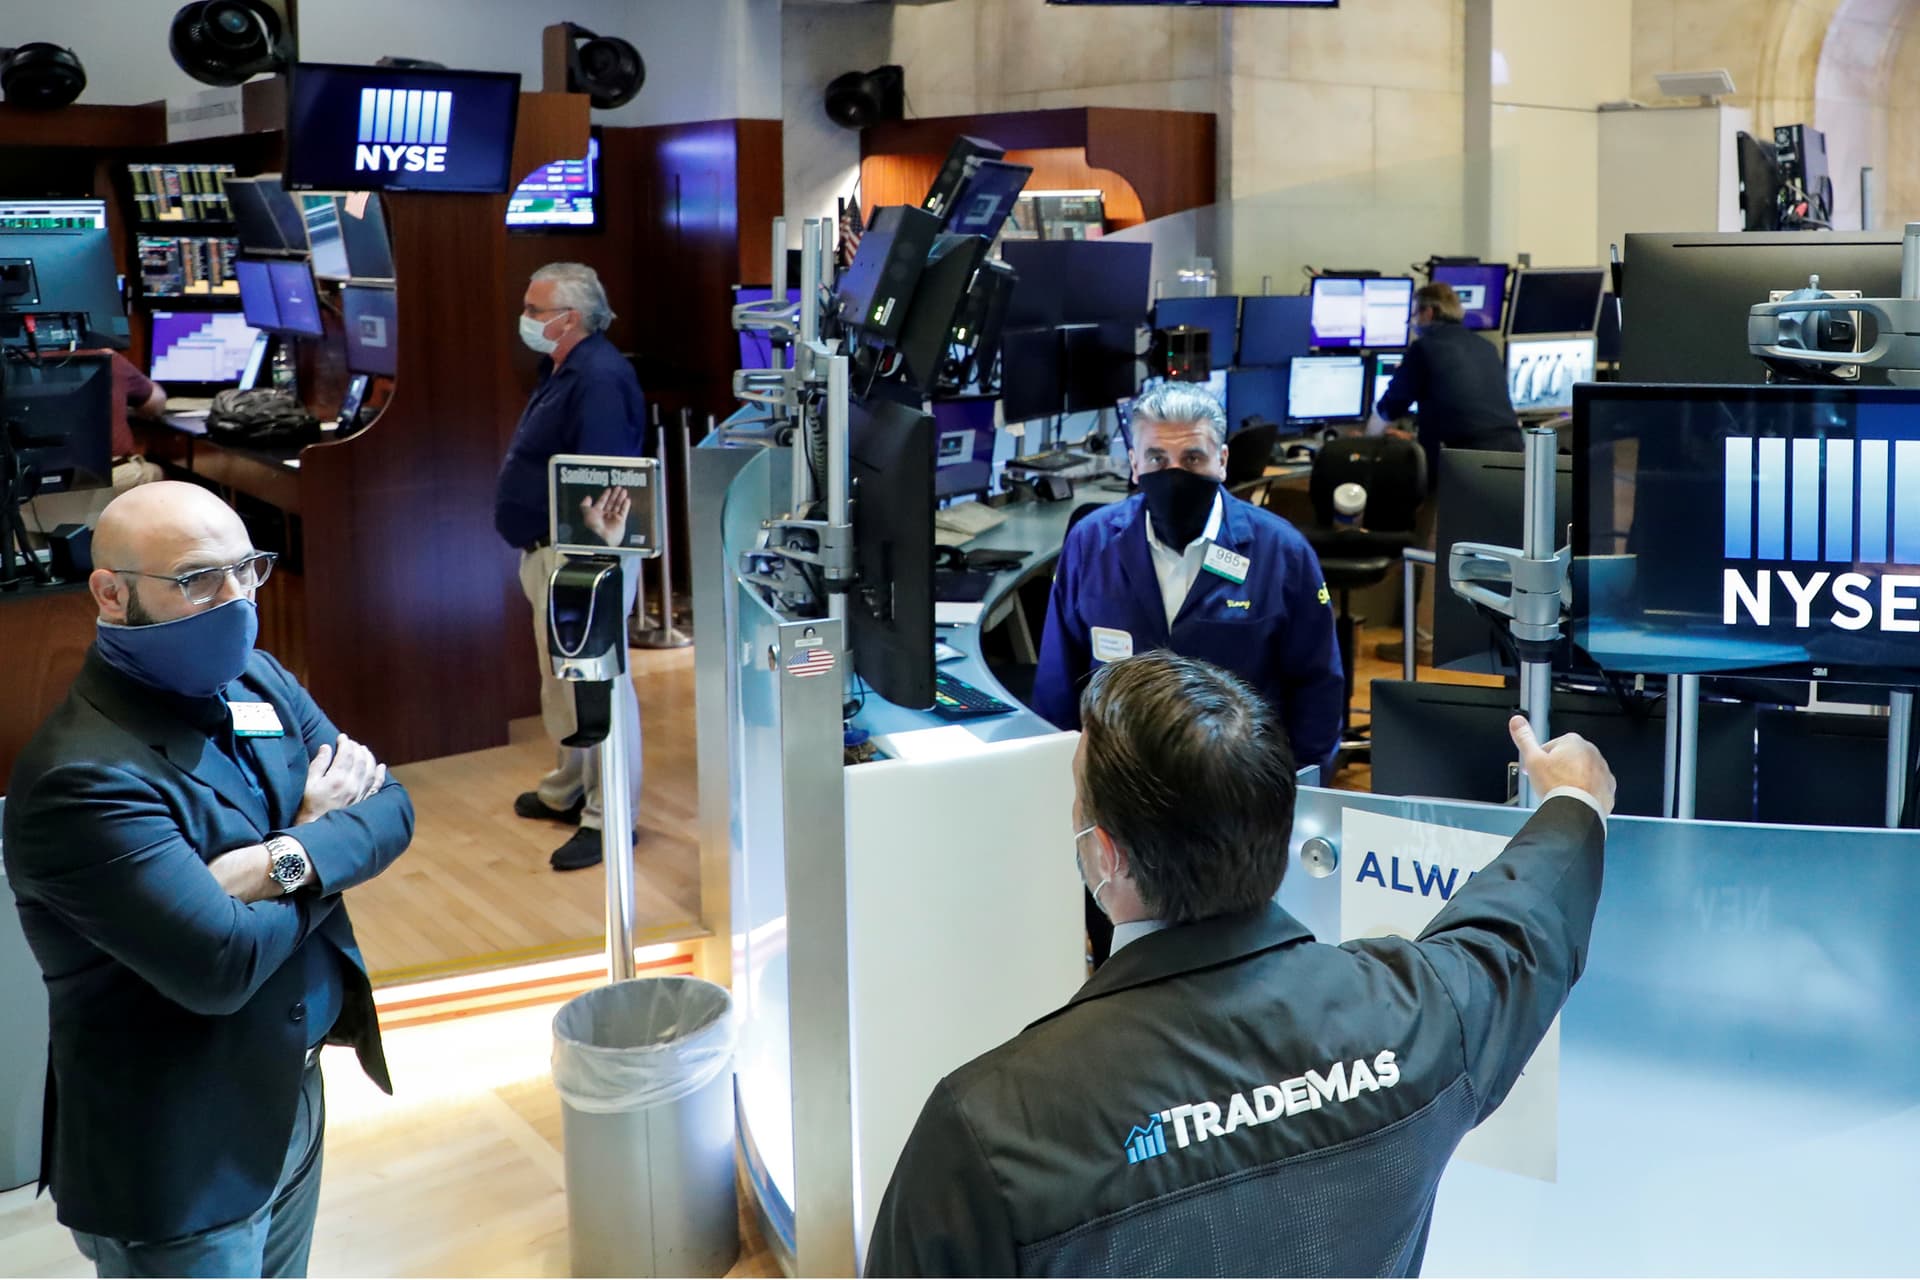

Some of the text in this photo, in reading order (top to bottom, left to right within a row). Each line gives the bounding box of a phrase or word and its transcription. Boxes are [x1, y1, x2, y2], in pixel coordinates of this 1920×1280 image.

[355, 144, 448, 172] NYSE
[611, 468, 647, 487] Station
[1216, 548, 1241, 568] 985
[1723, 568, 1920, 632] NYSE
[1812, 667, 1828, 677] 3M
[1356, 851, 1477, 901] ALW
